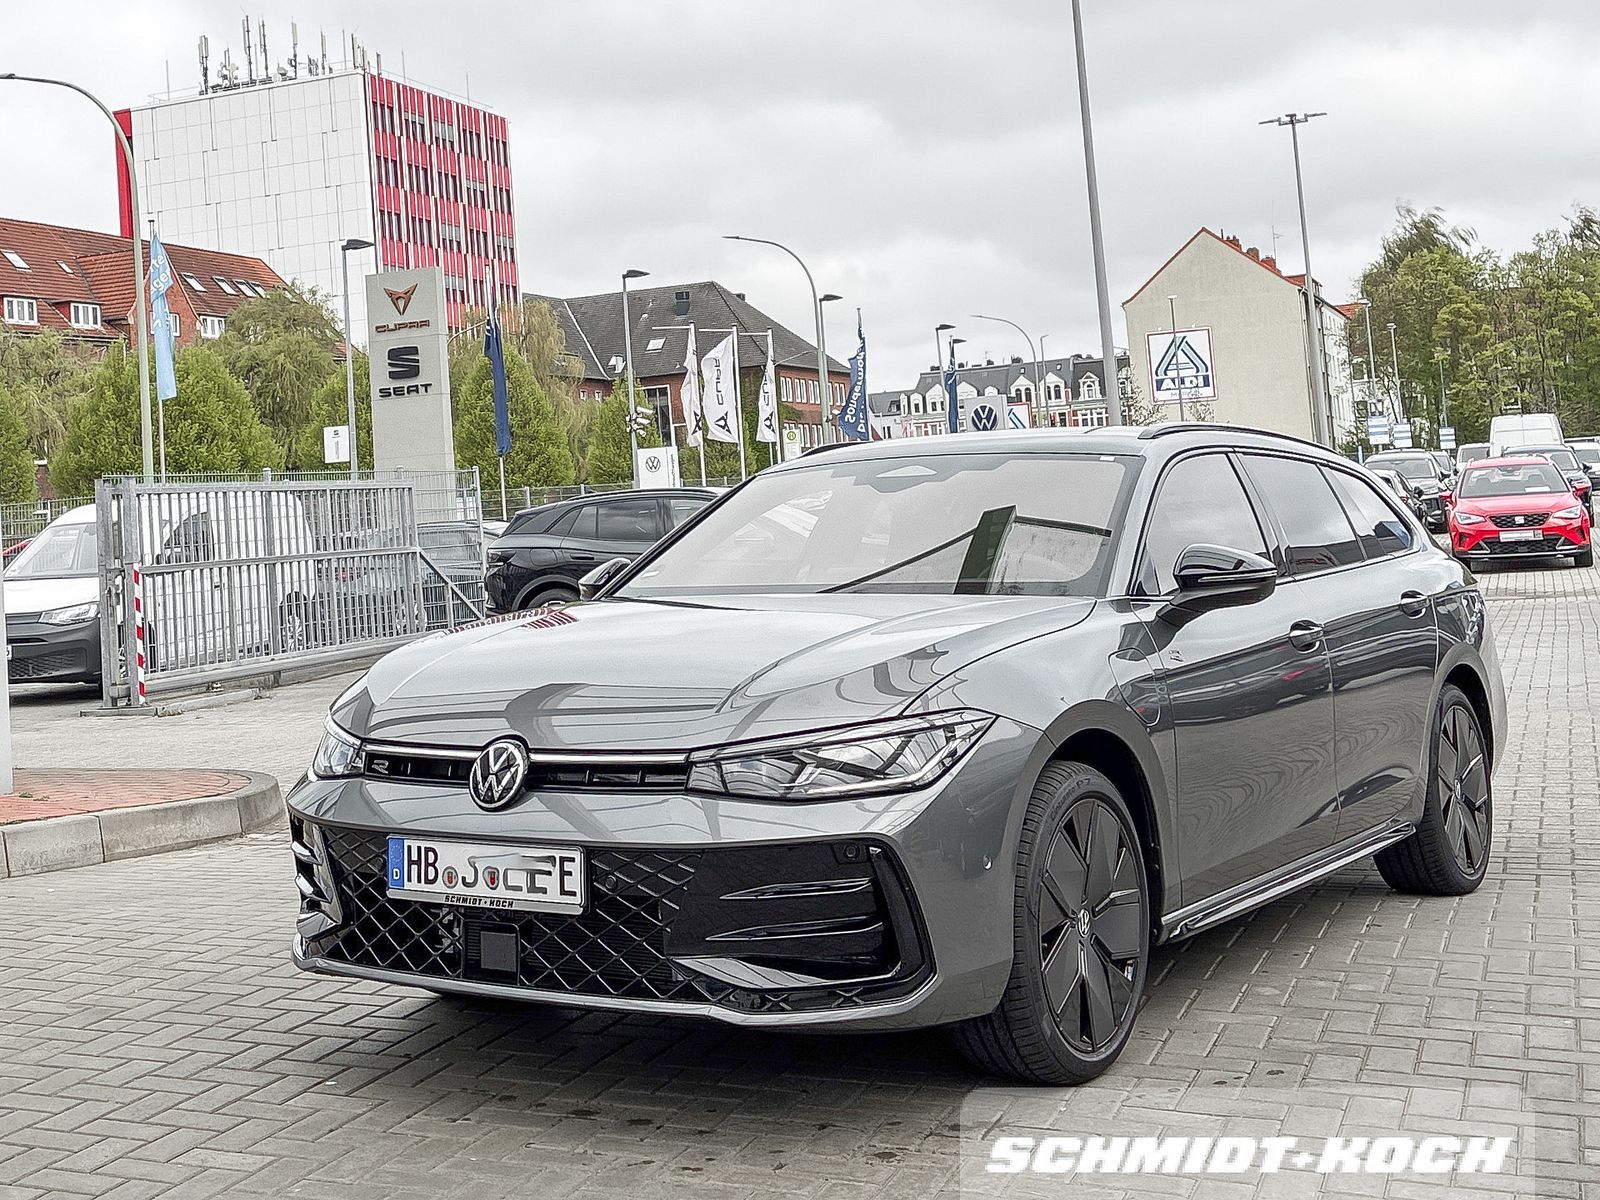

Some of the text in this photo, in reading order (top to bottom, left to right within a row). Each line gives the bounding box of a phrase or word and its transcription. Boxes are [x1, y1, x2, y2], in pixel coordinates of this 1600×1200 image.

[375, 319, 430, 333] CUPRA
[379, 383, 432, 398] SEAT
[1160, 375, 1204, 391] ALDI
[406, 845, 439, 885] HB
[444, 895, 514, 909] SCHMIDT KOCH
